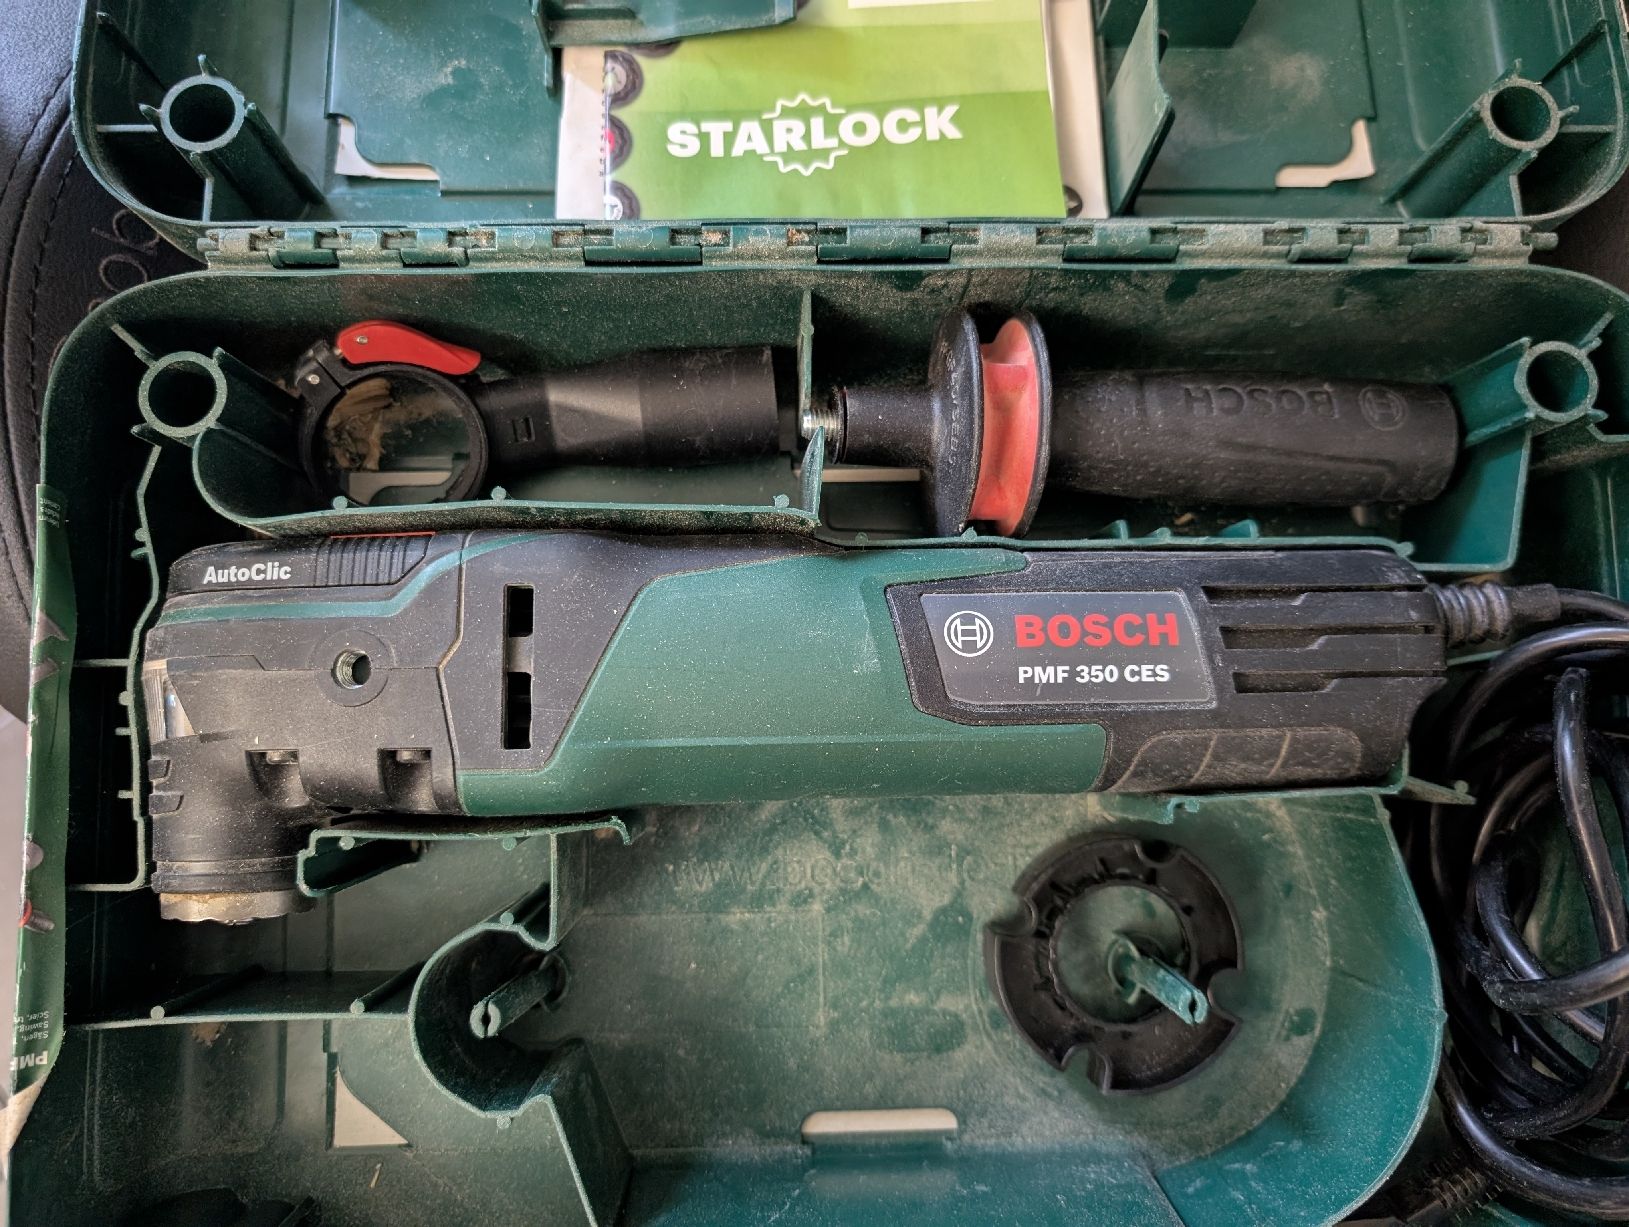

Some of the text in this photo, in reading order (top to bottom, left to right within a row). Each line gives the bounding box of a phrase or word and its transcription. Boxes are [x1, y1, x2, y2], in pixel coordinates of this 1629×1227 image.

[666, 103, 963, 158] STARLOCK
[1184, 383, 1341, 421] BOSCH
[203, 562, 292, 585] AutoClic
[1014, 612, 1180, 648] BOSCH
[1018, 663, 1170, 684] PMF 350 CES
